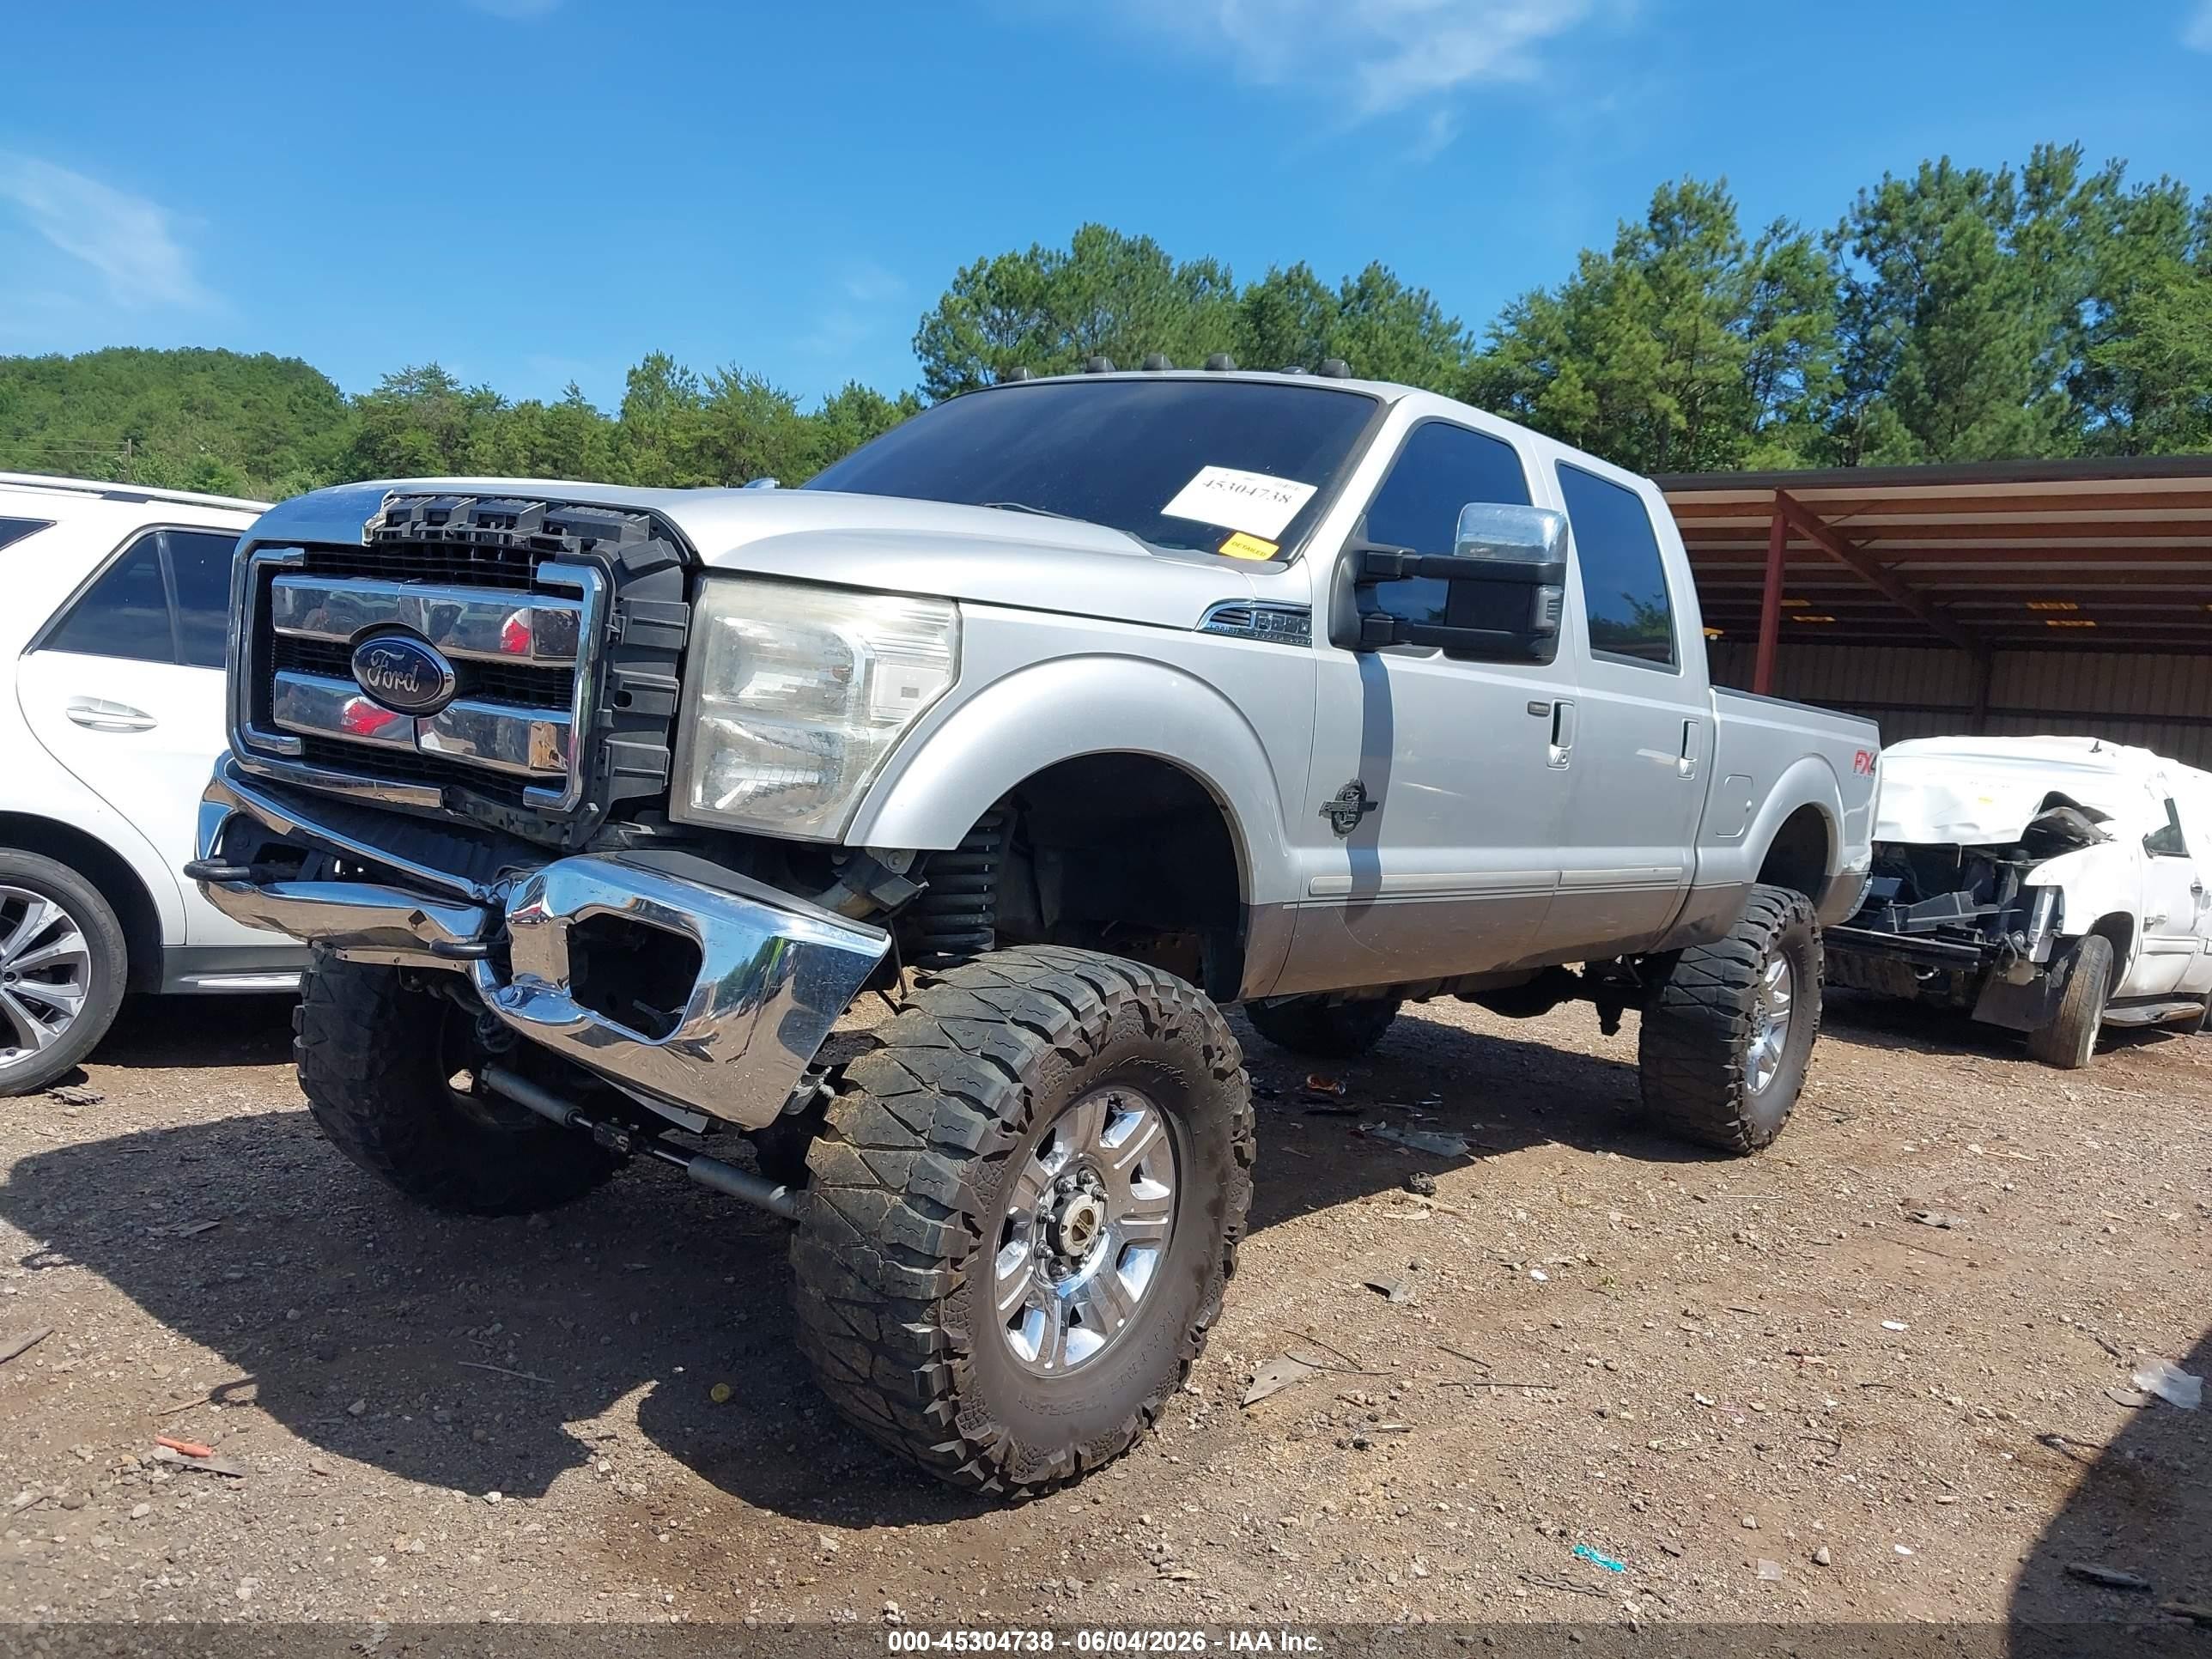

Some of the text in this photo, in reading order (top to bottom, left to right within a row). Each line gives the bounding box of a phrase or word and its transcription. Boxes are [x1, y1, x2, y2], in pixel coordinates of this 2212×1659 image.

[1202, 479, 1292, 503] 45304738
[1231, 541, 1267, 556] DETAILED
[367, 648, 420, 692] Ford
